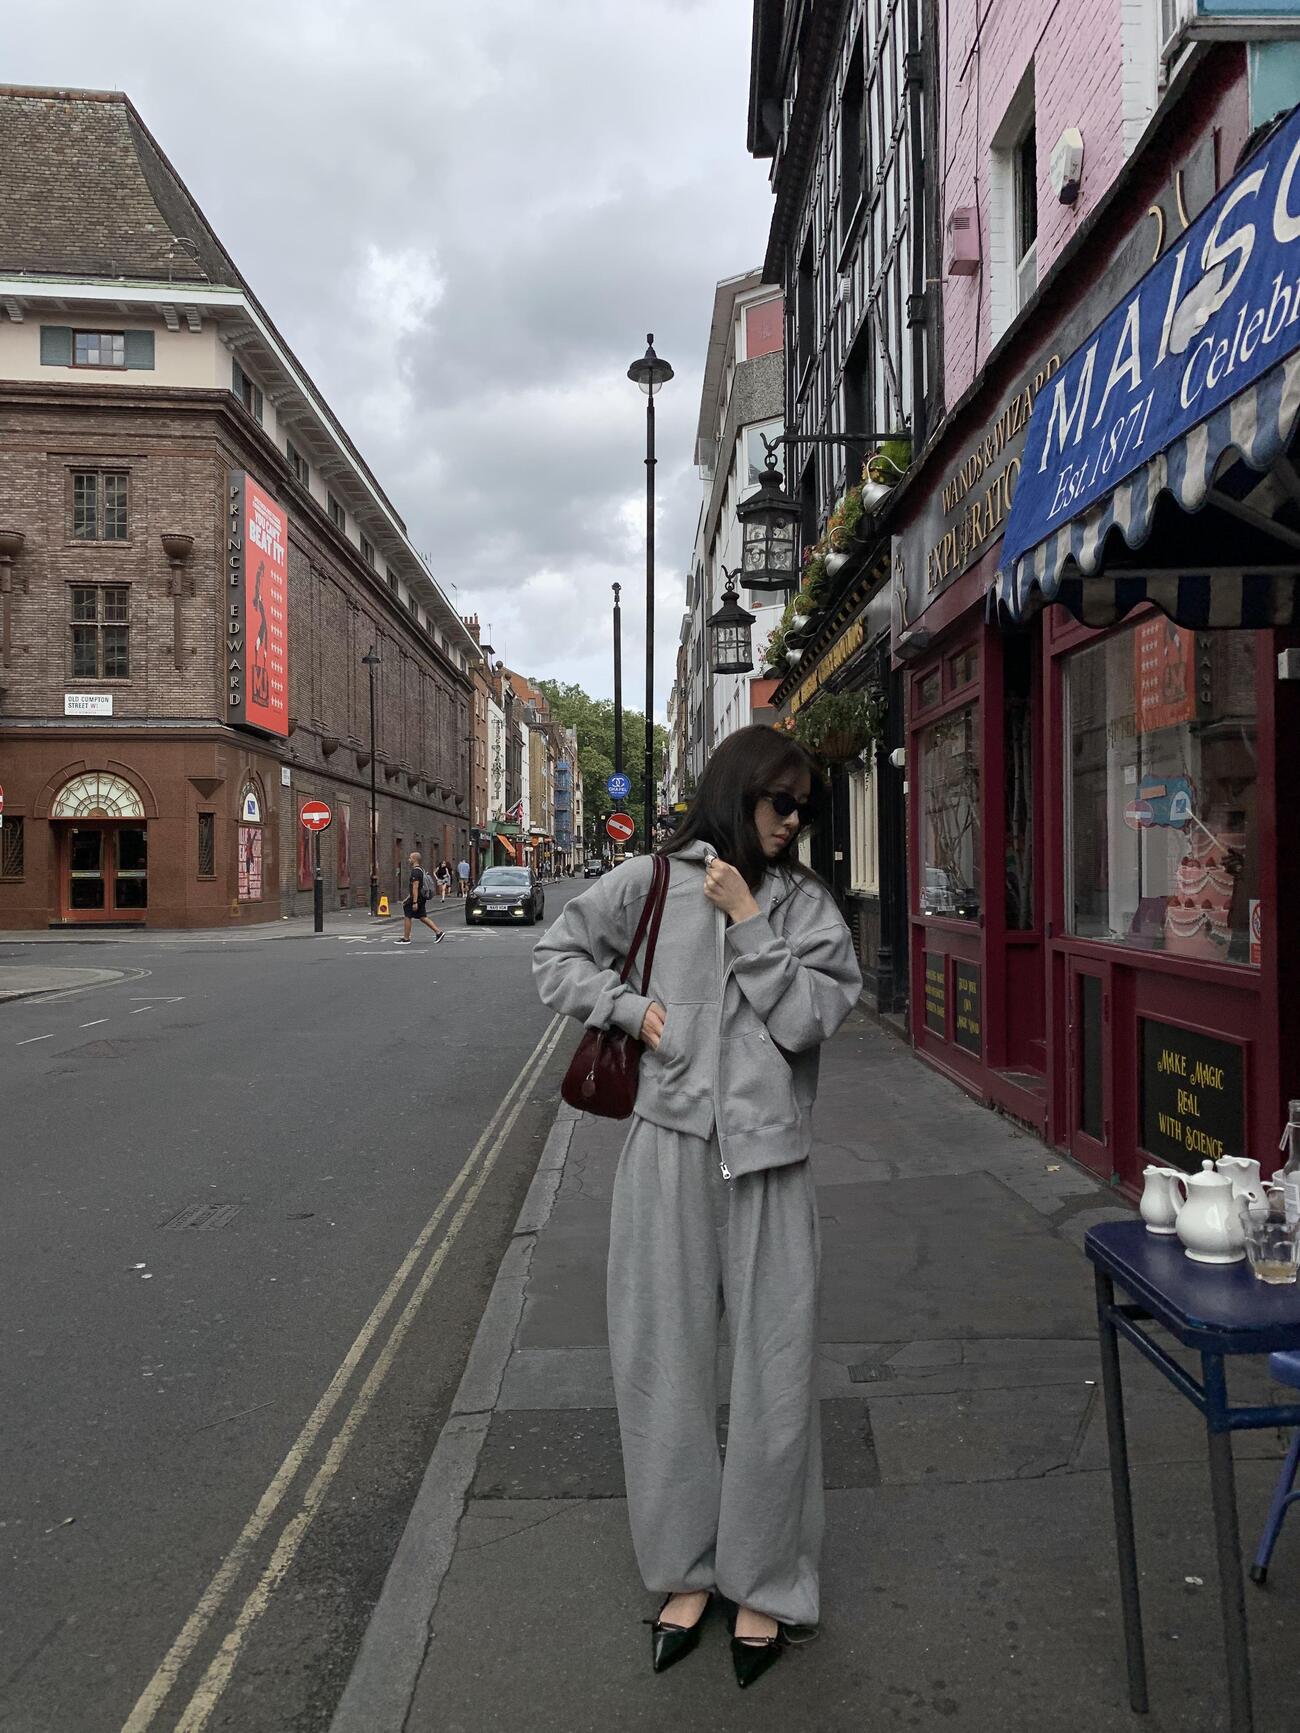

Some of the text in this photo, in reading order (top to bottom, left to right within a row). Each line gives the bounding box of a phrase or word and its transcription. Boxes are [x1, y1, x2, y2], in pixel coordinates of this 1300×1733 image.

[1088, 386, 1156, 484] 1871
[228, 486, 241, 587] PRINCE
[249, 518, 273, 557] BEAT
[226, 604, 243, 706] EDWARD
[1157, 1049, 1225, 1091] MAKE MAGIC
[1177, 1088, 1200, 1117] REAL
[1158, 1112, 1224, 1160] WITH SCIENCE
